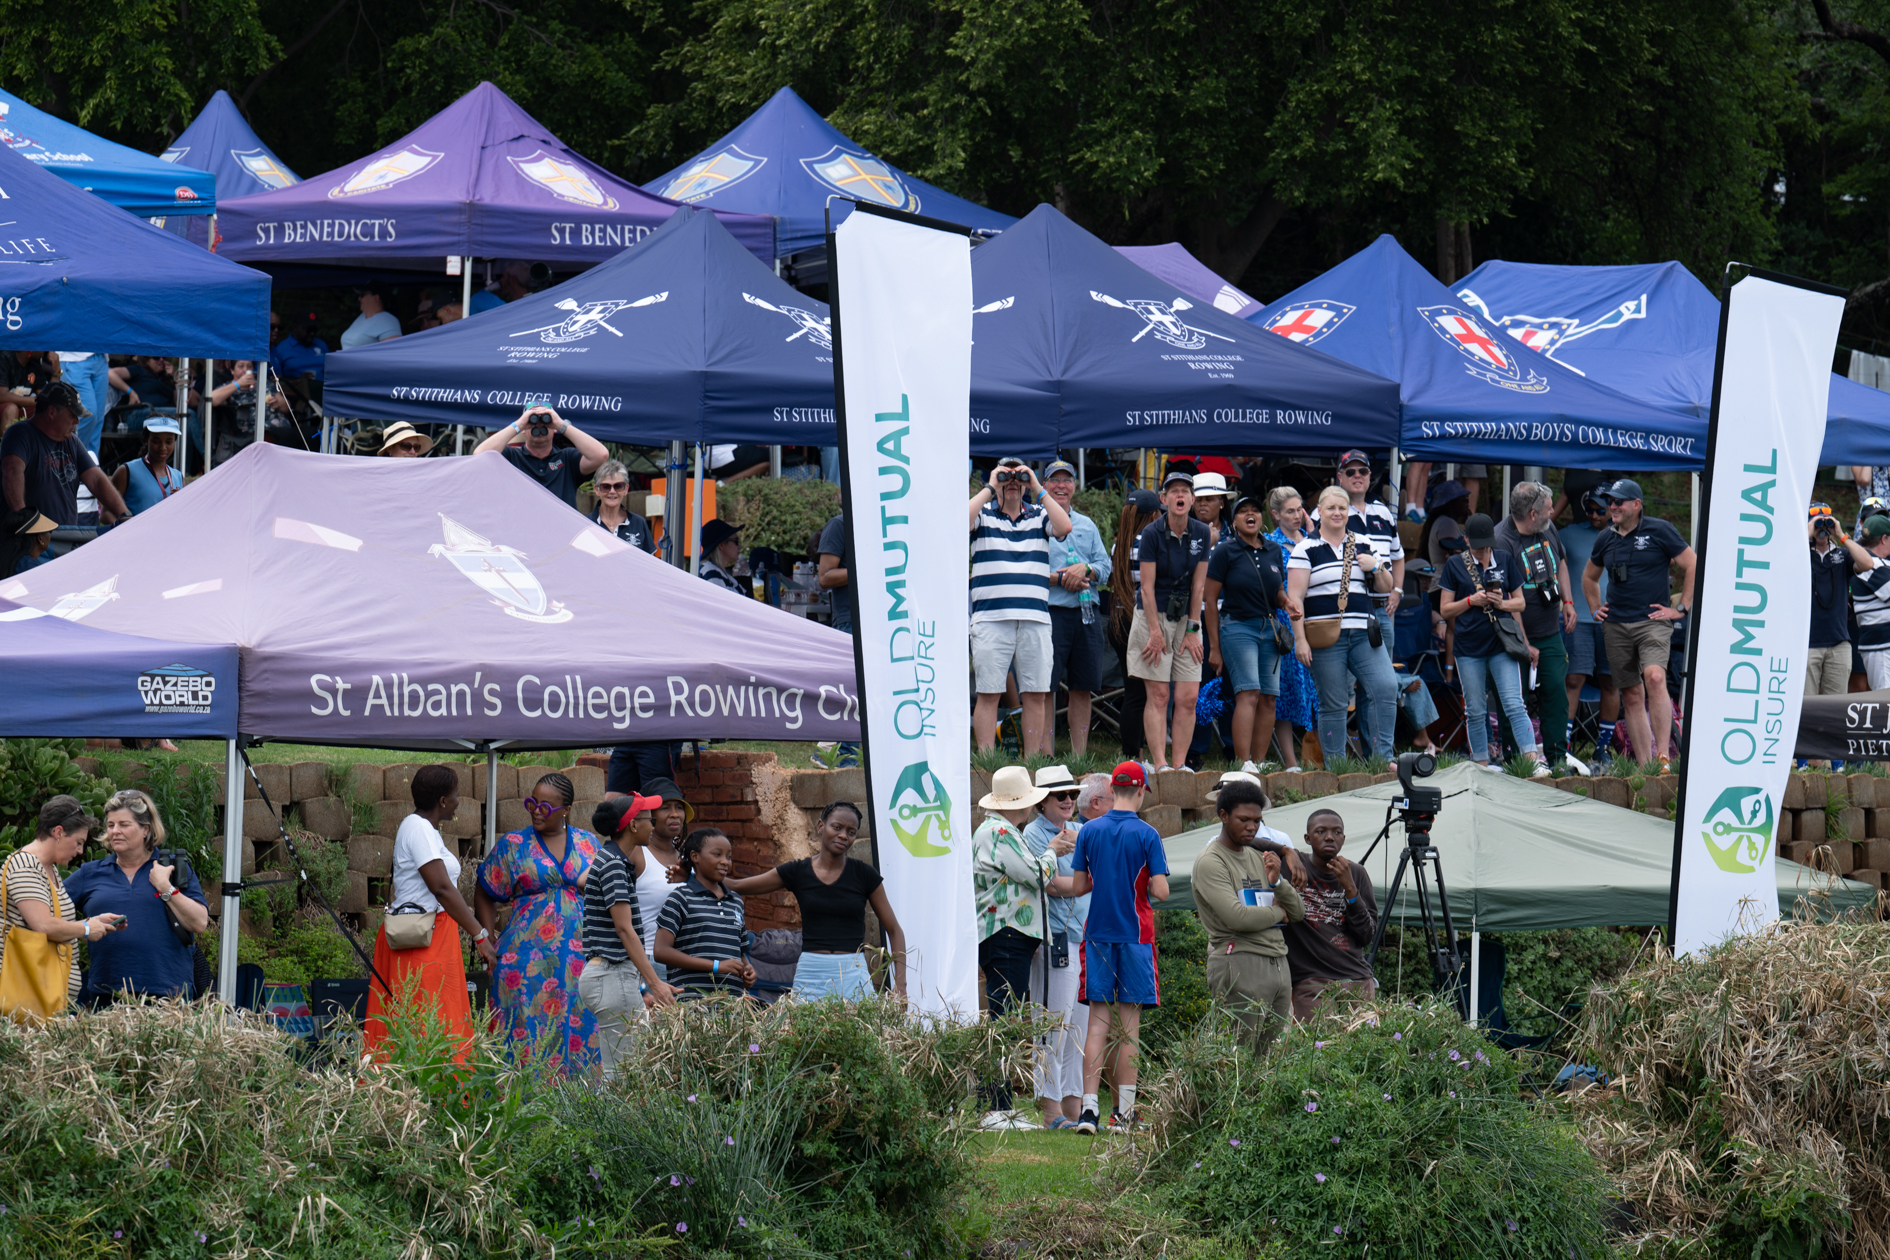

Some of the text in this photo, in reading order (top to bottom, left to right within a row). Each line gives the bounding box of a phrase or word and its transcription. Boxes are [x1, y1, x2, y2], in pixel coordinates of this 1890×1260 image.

[256, 218, 396, 245] ST BENEDICT'S
[550, 222, 659, 248] ST BENED
[391, 386, 410, 400] ST
[410, 387, 482, 404] STITHIANS
[557, 394, 622, 411] ROWING
[773, 406, 790, 422] ST
[1126, 408, 1332, 426] ST STITHIANS COLLEGE ROWING
[1421, 420, 1696, 456] ST STITHIANS BOYS' COLLEGE SPORT
[137, 675, 216, 692] GAZEBO
[141, 690, 213, 706] WORLD
[310, 673, 352, 717] St
[364, 671, 502, 718] Alban's
[516, 673, 657, 730] College
[667, 675, 804, 730] Rowing
[1762, 656, 1789, 764] INSURE
[1846, 702, 1880, 728] ST
